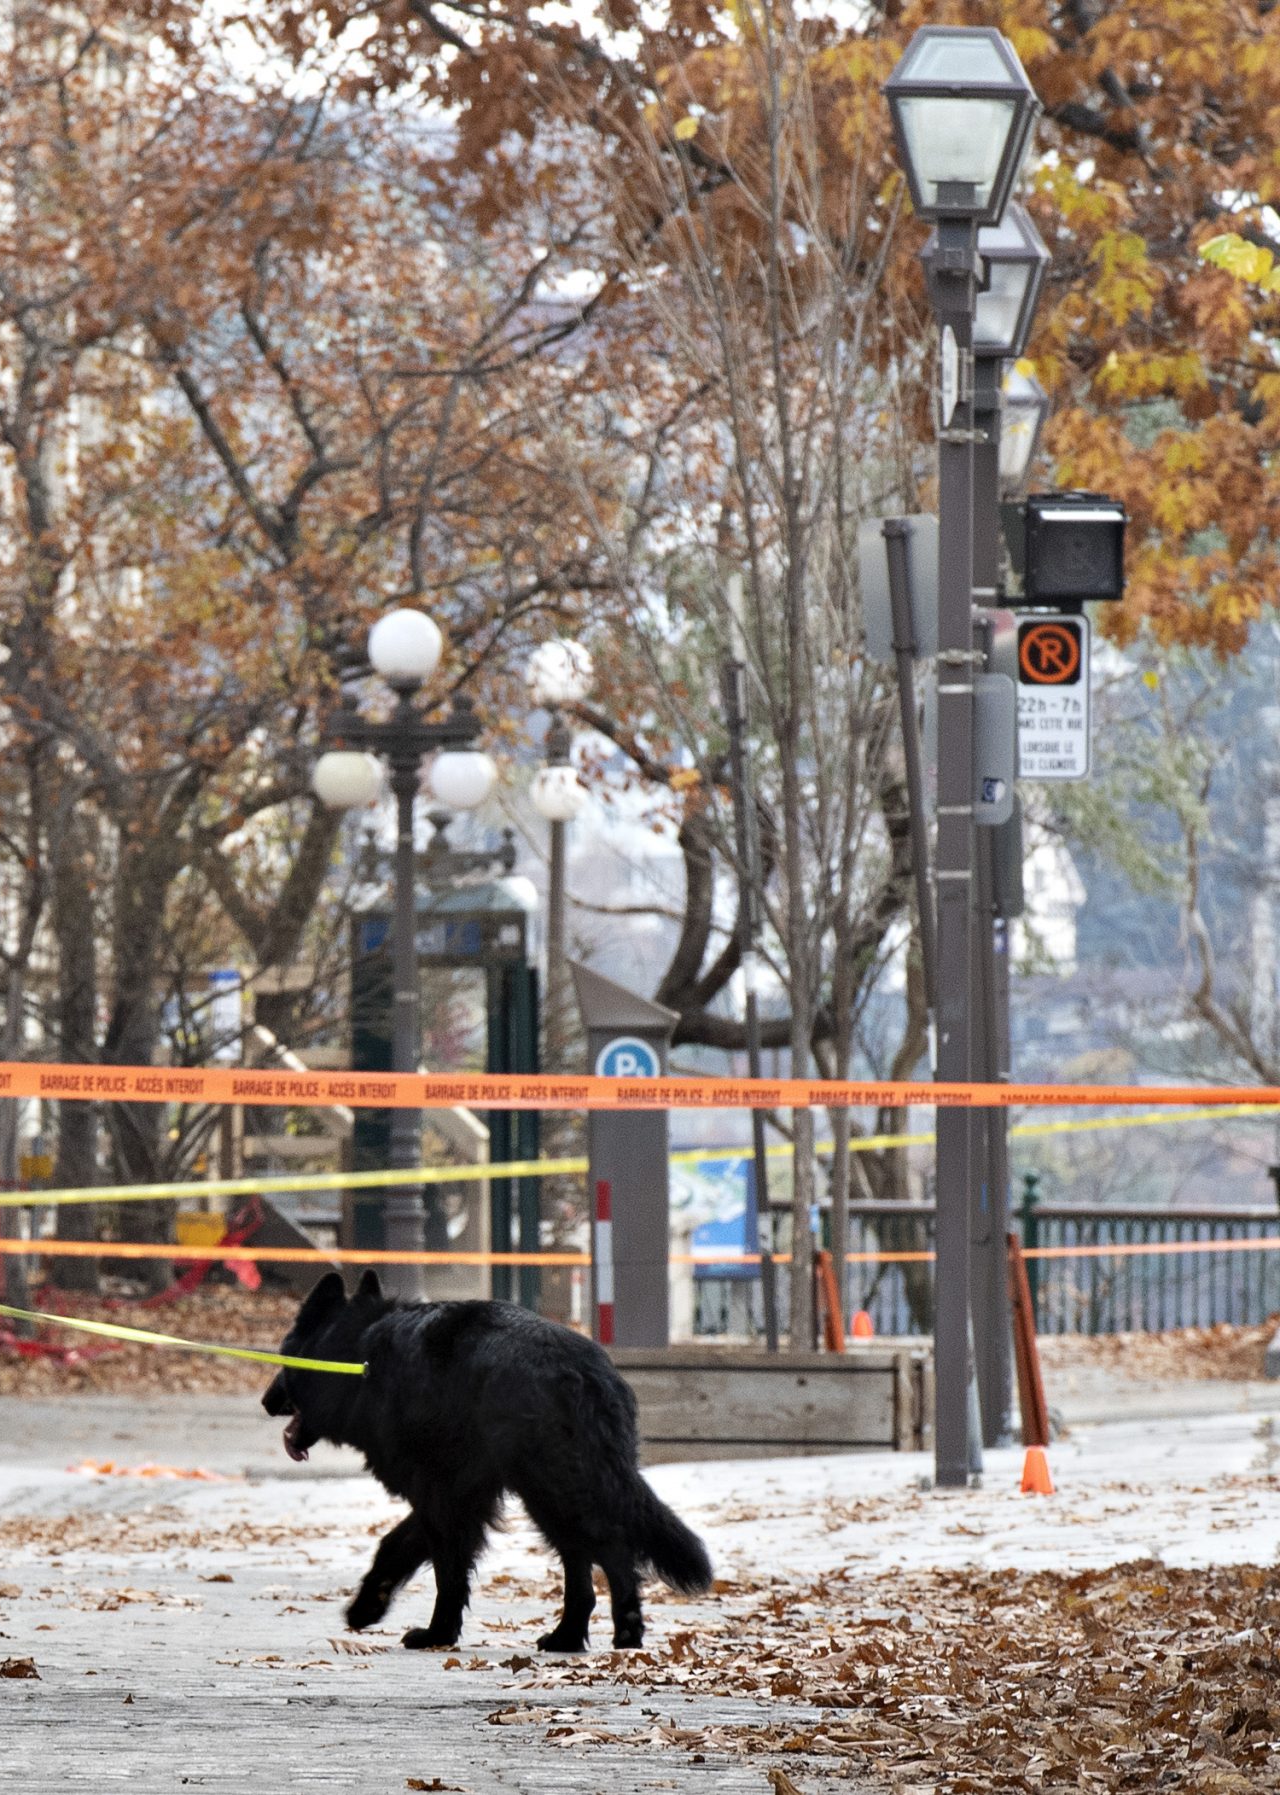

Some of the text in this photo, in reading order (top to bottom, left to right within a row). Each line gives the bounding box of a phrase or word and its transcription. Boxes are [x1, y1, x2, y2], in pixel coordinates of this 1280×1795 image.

[41, 1074, 80, 1091] BARRAGE
[84, 1076, 94, 1091] DE
[97, 1076, 126, 1092] POLICE
[166, 1079, 203, 1095] INTERDIT
[233, 1079, 272, 1096] BARRAGE
[275, 1081, 286, 1096] DE
[289, 1081, 319, 1097] POLICE
[359, 1083, 396, 1099] INTERDIT
